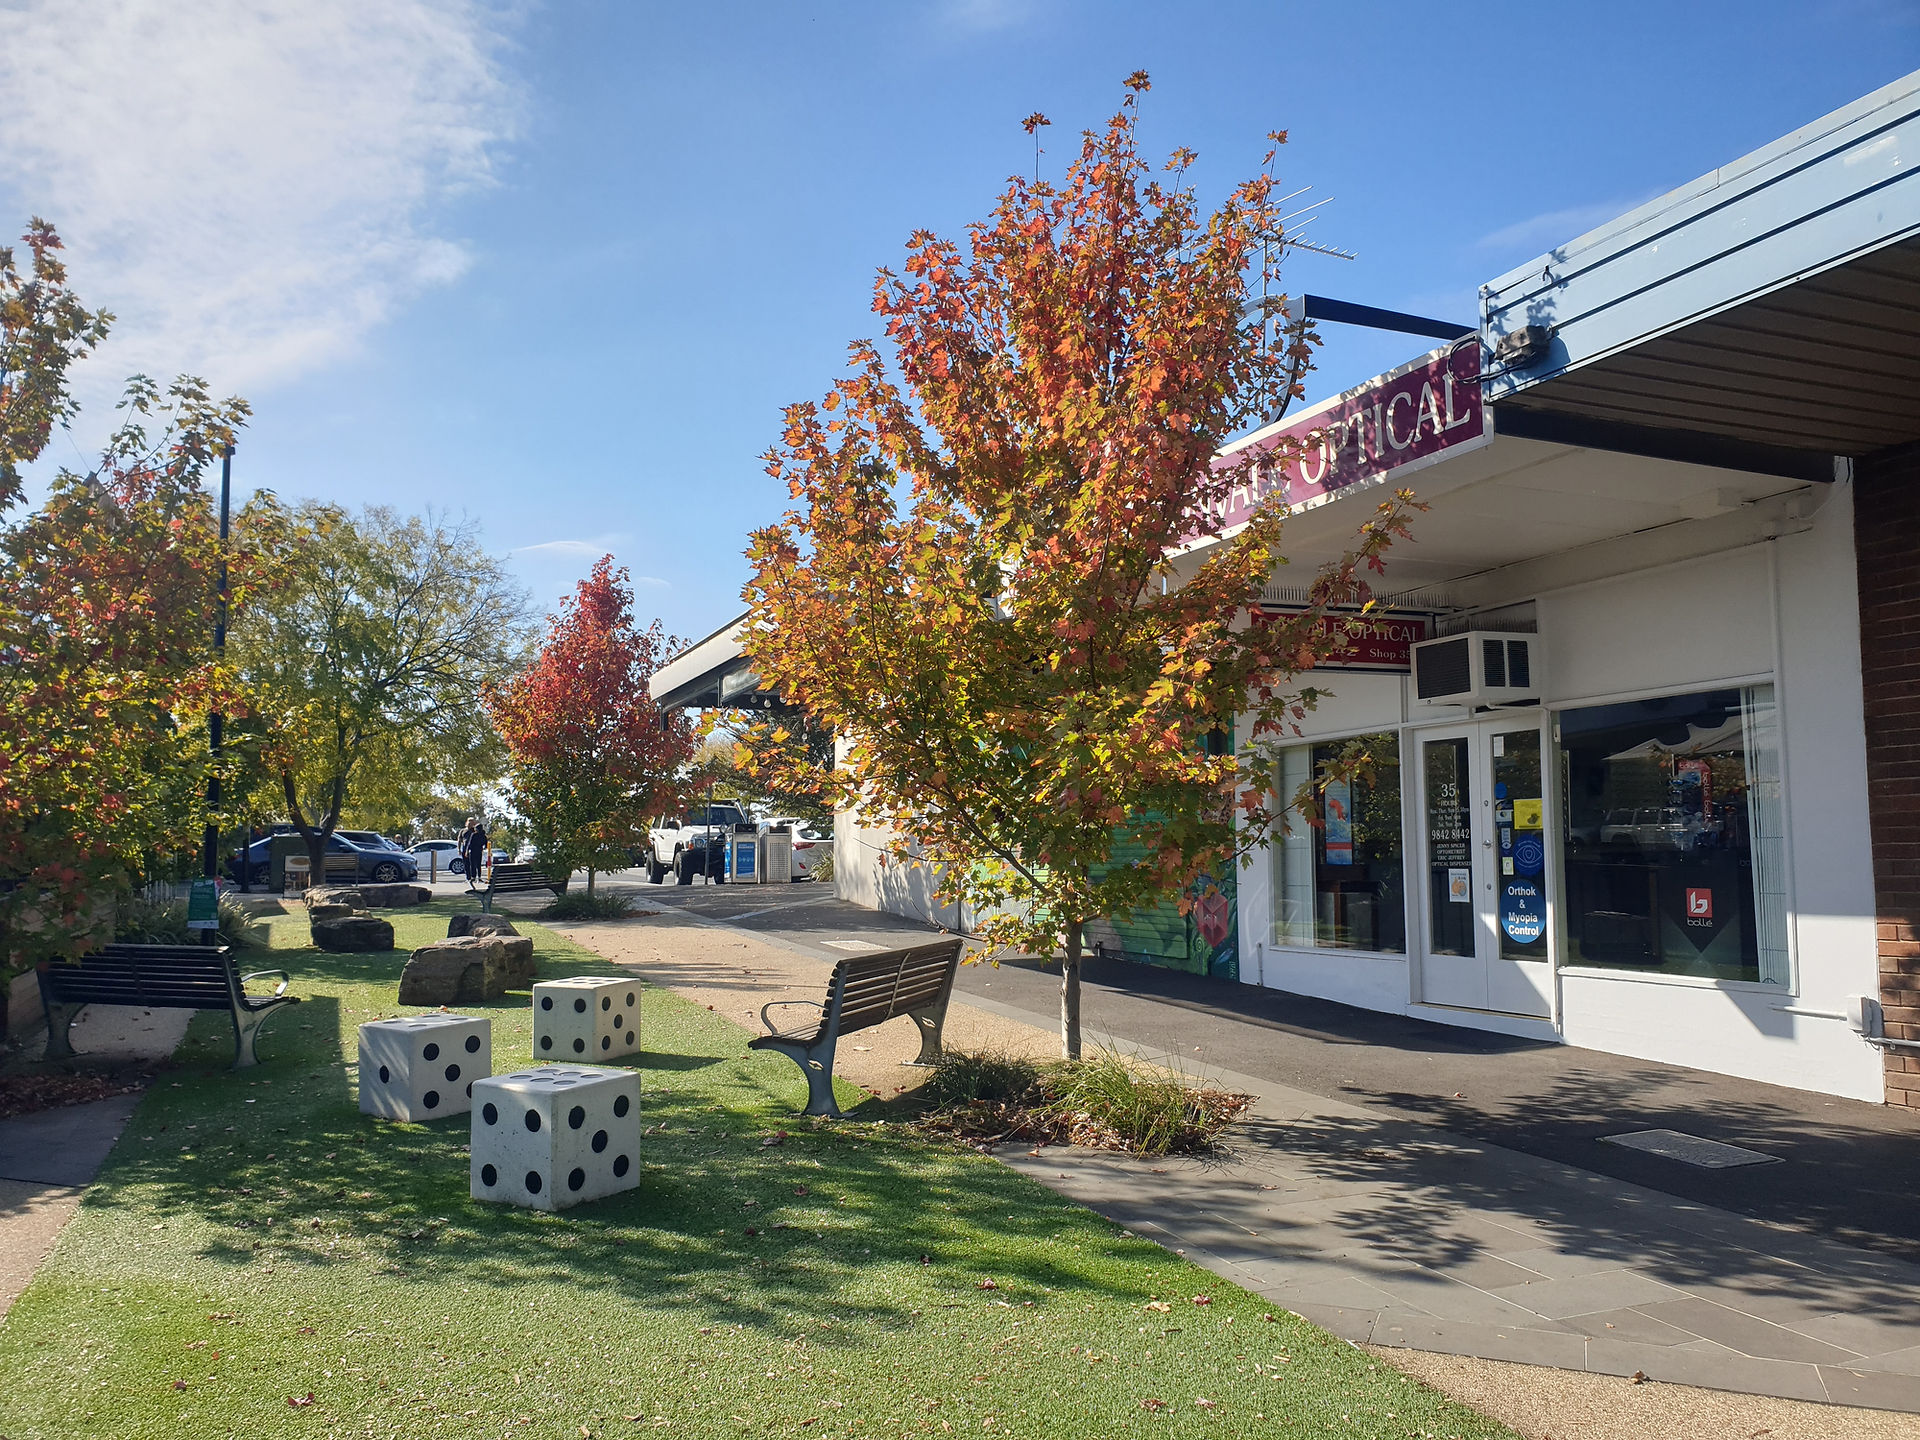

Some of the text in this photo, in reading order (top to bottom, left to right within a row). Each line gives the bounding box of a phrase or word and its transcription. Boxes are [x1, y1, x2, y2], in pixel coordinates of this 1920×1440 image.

[1299, 373, 1471, 486] OPTICAL
[1369, 648, 1396, 660] Shop
[1441, 783, 1456, 798] 35
[1431, 828, 1470, 840] 9842 8442
[1508, 886, 1536, 896] Orthok
[1519, 899, 1526, 909] &
[1508, 912, 1538, 924] Myopia
[1508, 925, 1539, 936] Control
